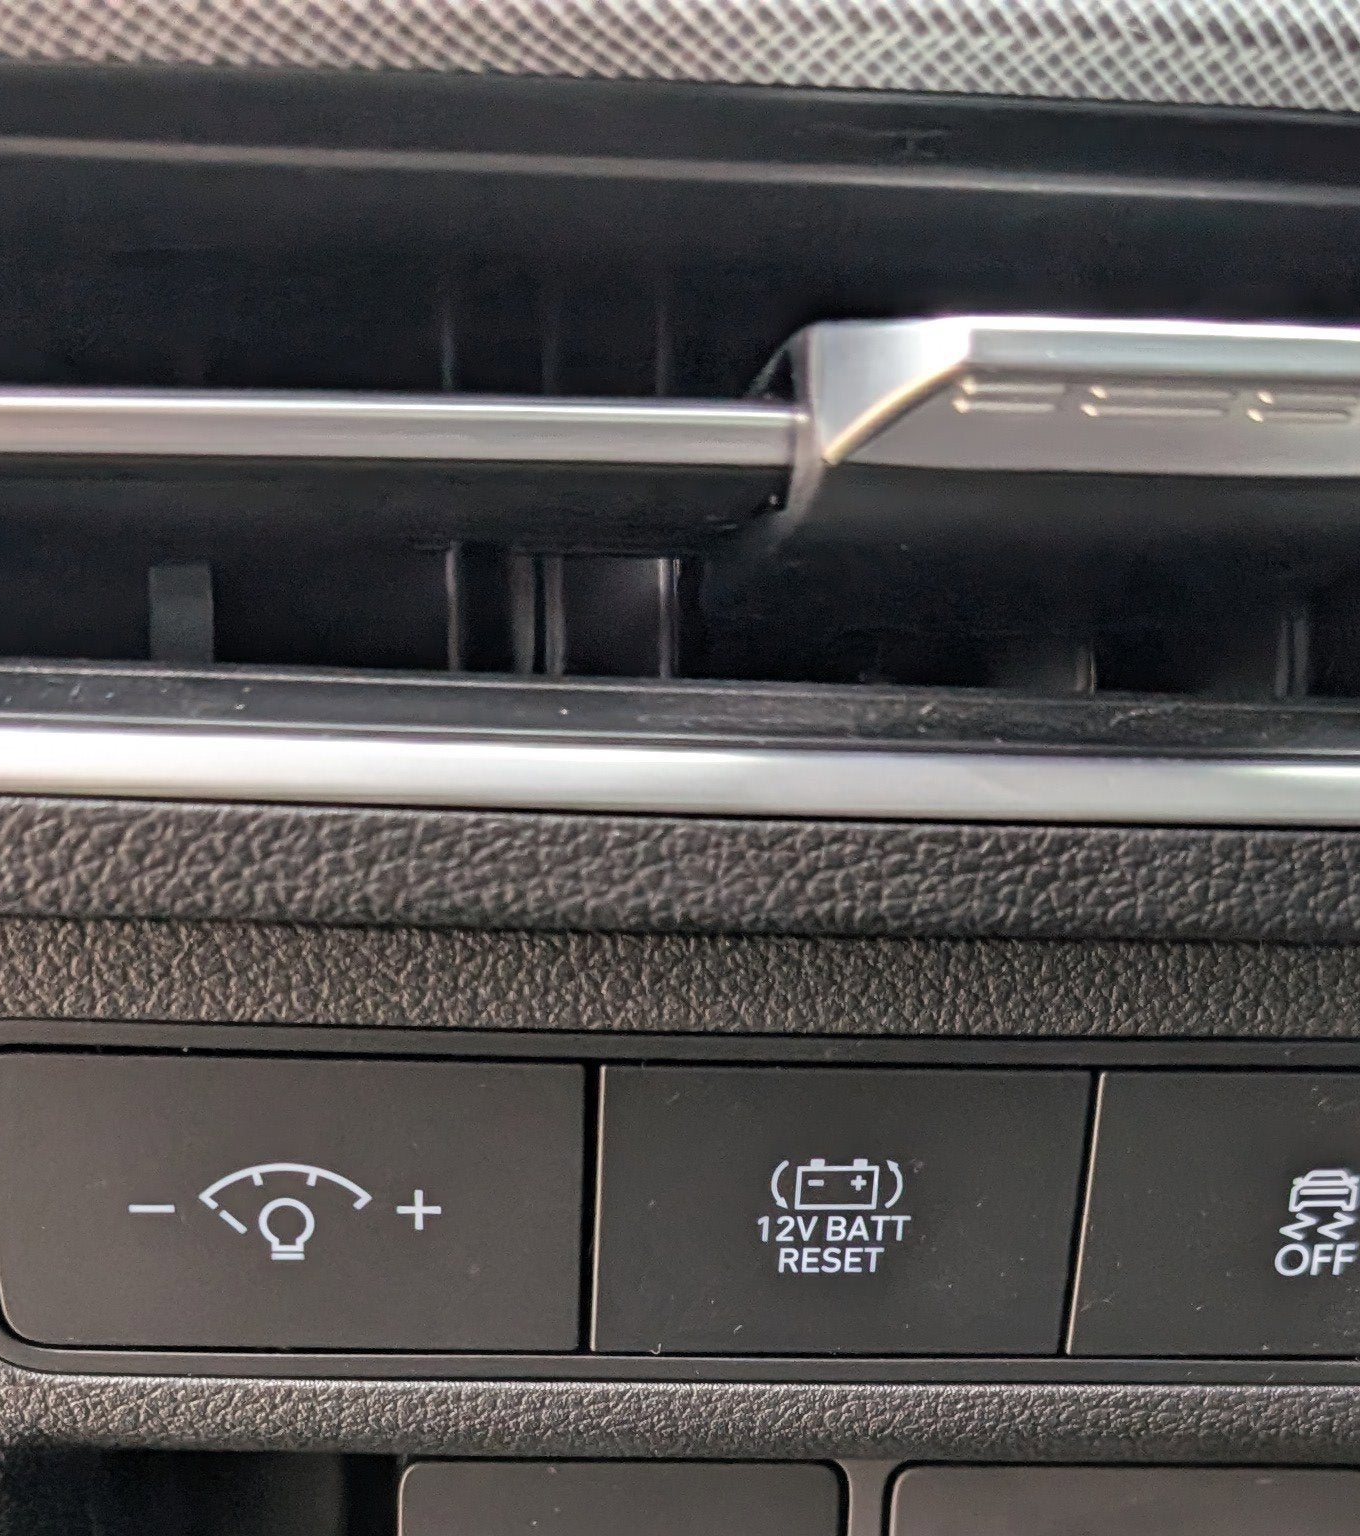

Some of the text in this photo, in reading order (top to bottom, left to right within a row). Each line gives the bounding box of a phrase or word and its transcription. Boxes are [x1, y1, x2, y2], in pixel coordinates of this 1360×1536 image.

[757, 1215, 912, 1242] 12V BATT
[778, 1247, 885, 1273] RESET
[1274, 1243, 1358, 1277] OFF
